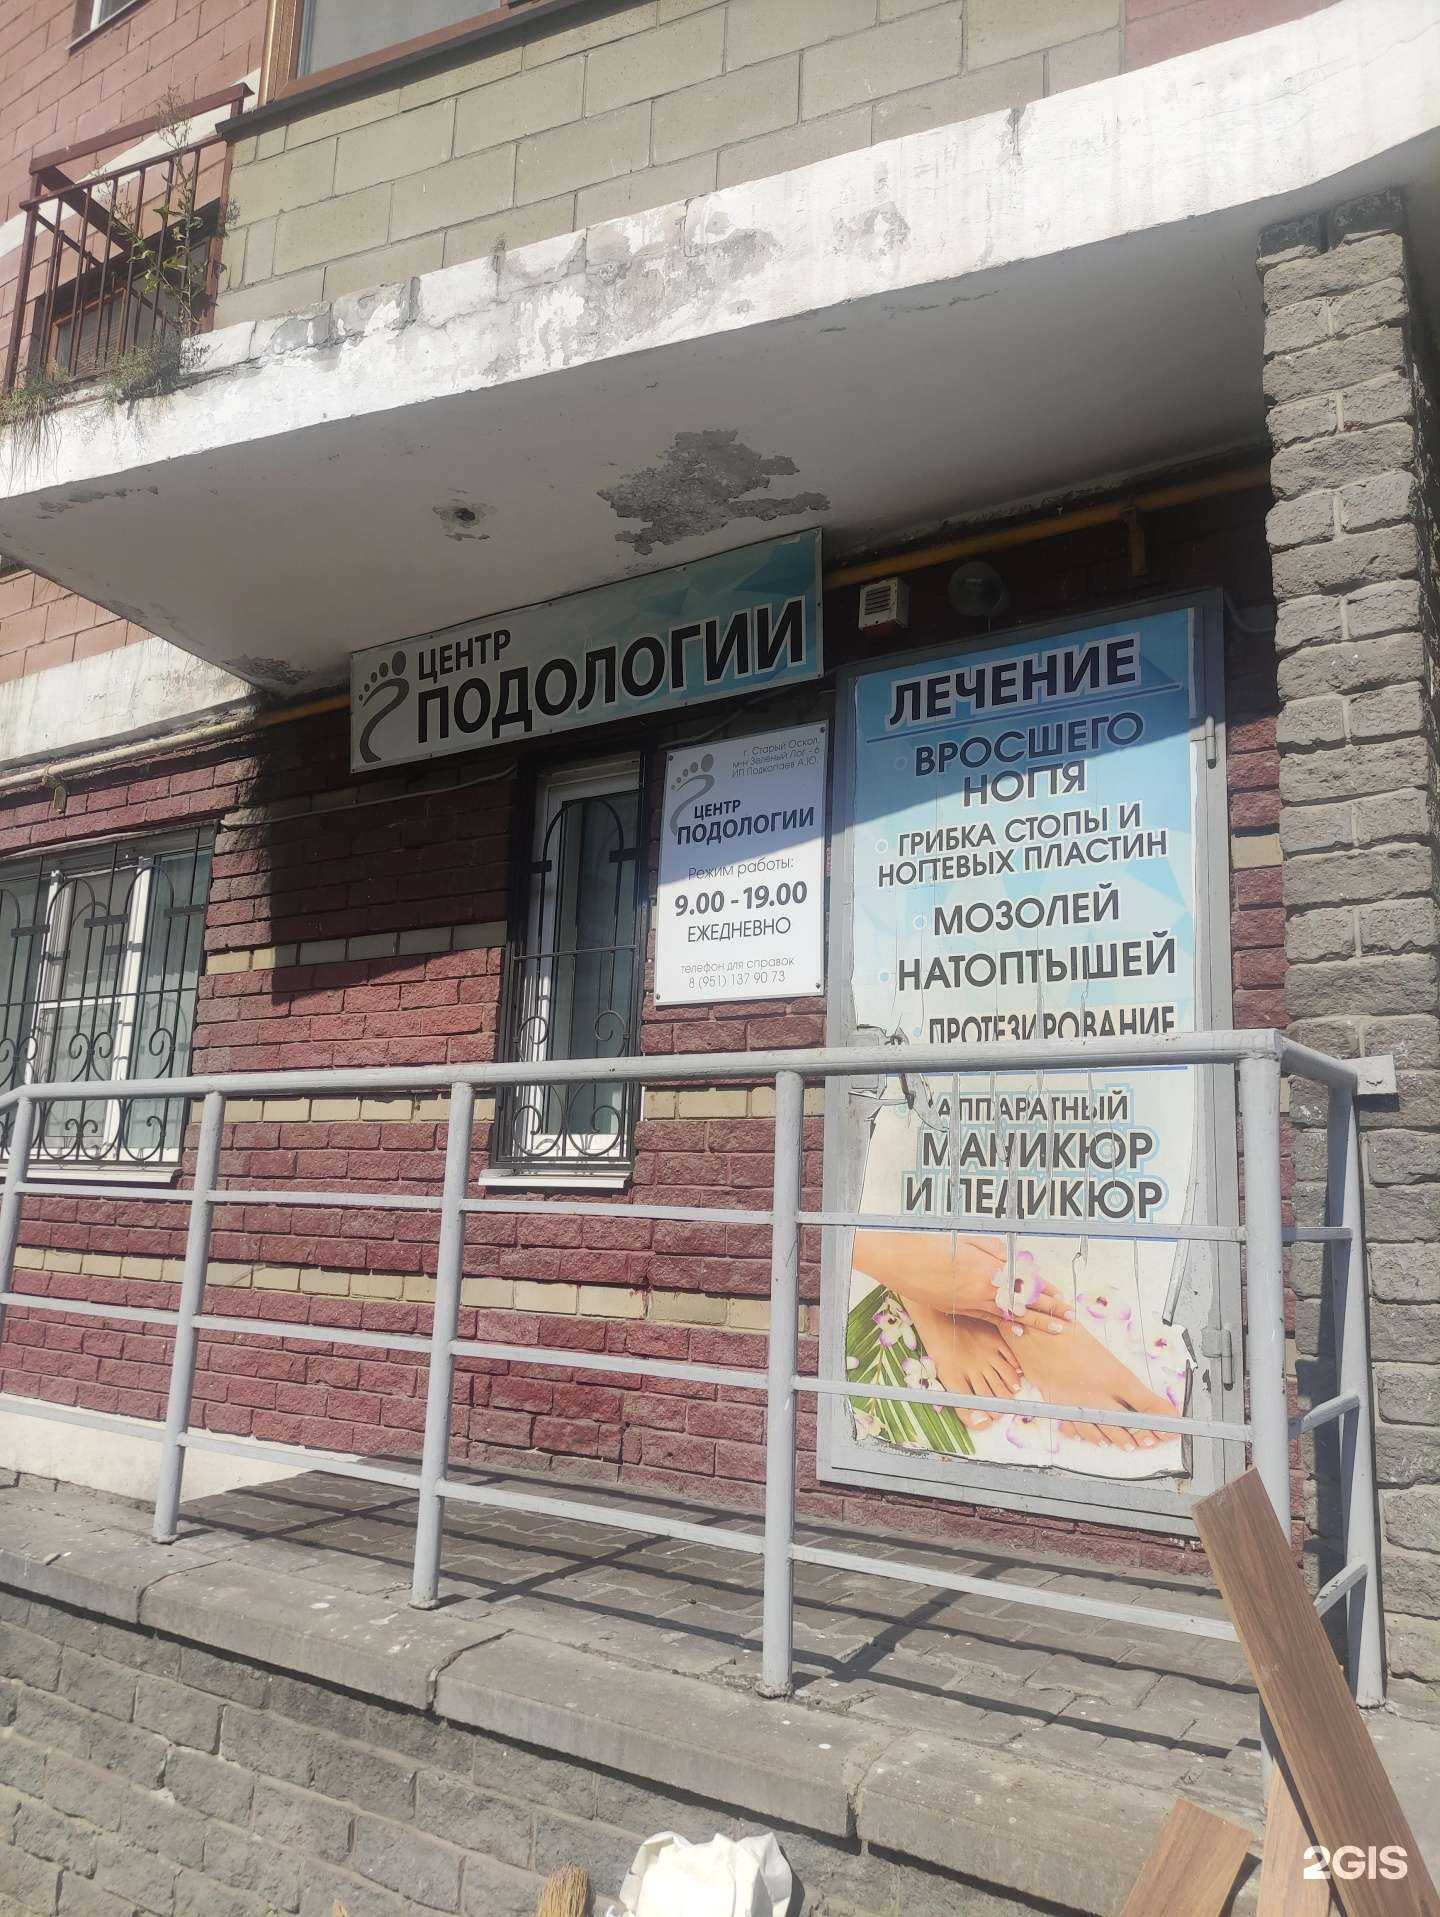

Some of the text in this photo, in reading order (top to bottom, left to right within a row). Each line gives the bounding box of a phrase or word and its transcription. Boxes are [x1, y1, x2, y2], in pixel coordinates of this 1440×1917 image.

[418, 630, 511, 684] ЦЕНТР
[418, 597, 806, 744] ПОДОЛОГИИ
[888, 638, 1136, 726] ЛЕЧЕНИЕ
[751, 743, 786, 756] Старый
[788, 737, 818, 749] Оскол
[915, 712, 1144, 776] ВРОСШЕГО
[732, 768, 745, 777] ИП
[963, 760, 1085, 807] НОГТЯ
[677, 806, 814, 845] ПОДОЛОГИИ
[694, 800, 741, 820] ЦЕНТР
[899, 803, 1141, 856] ГРИБКА СТОПЫ И
[688, 857, 794, 880] Режим работы:
[878, 831, 1167, 887] НОГТЕВЫХ ПЛАСТИН
[674, 891, 725, 916] 9.00
[743, 881, 808, 909] 19.00
[934, 882, 1119, 936] МОЗОЛЕЙ
[688, 917, 791, 942] ЕЖЕДНЕВНО
[681, 957, 794, 975] телефон для справок
[688, 970, 786, 990] 8 (951) 137 90 73
[899, 930, 1175, 991] НАТОПТЫШЕЙ
[938, 1089, 1128, 1121] АППАРАТНЫЙ
[923, 1131, 1153, 1170] МАНИКЮР
[906, 1176, 1163, 1219] И ПЕДИКЮР
